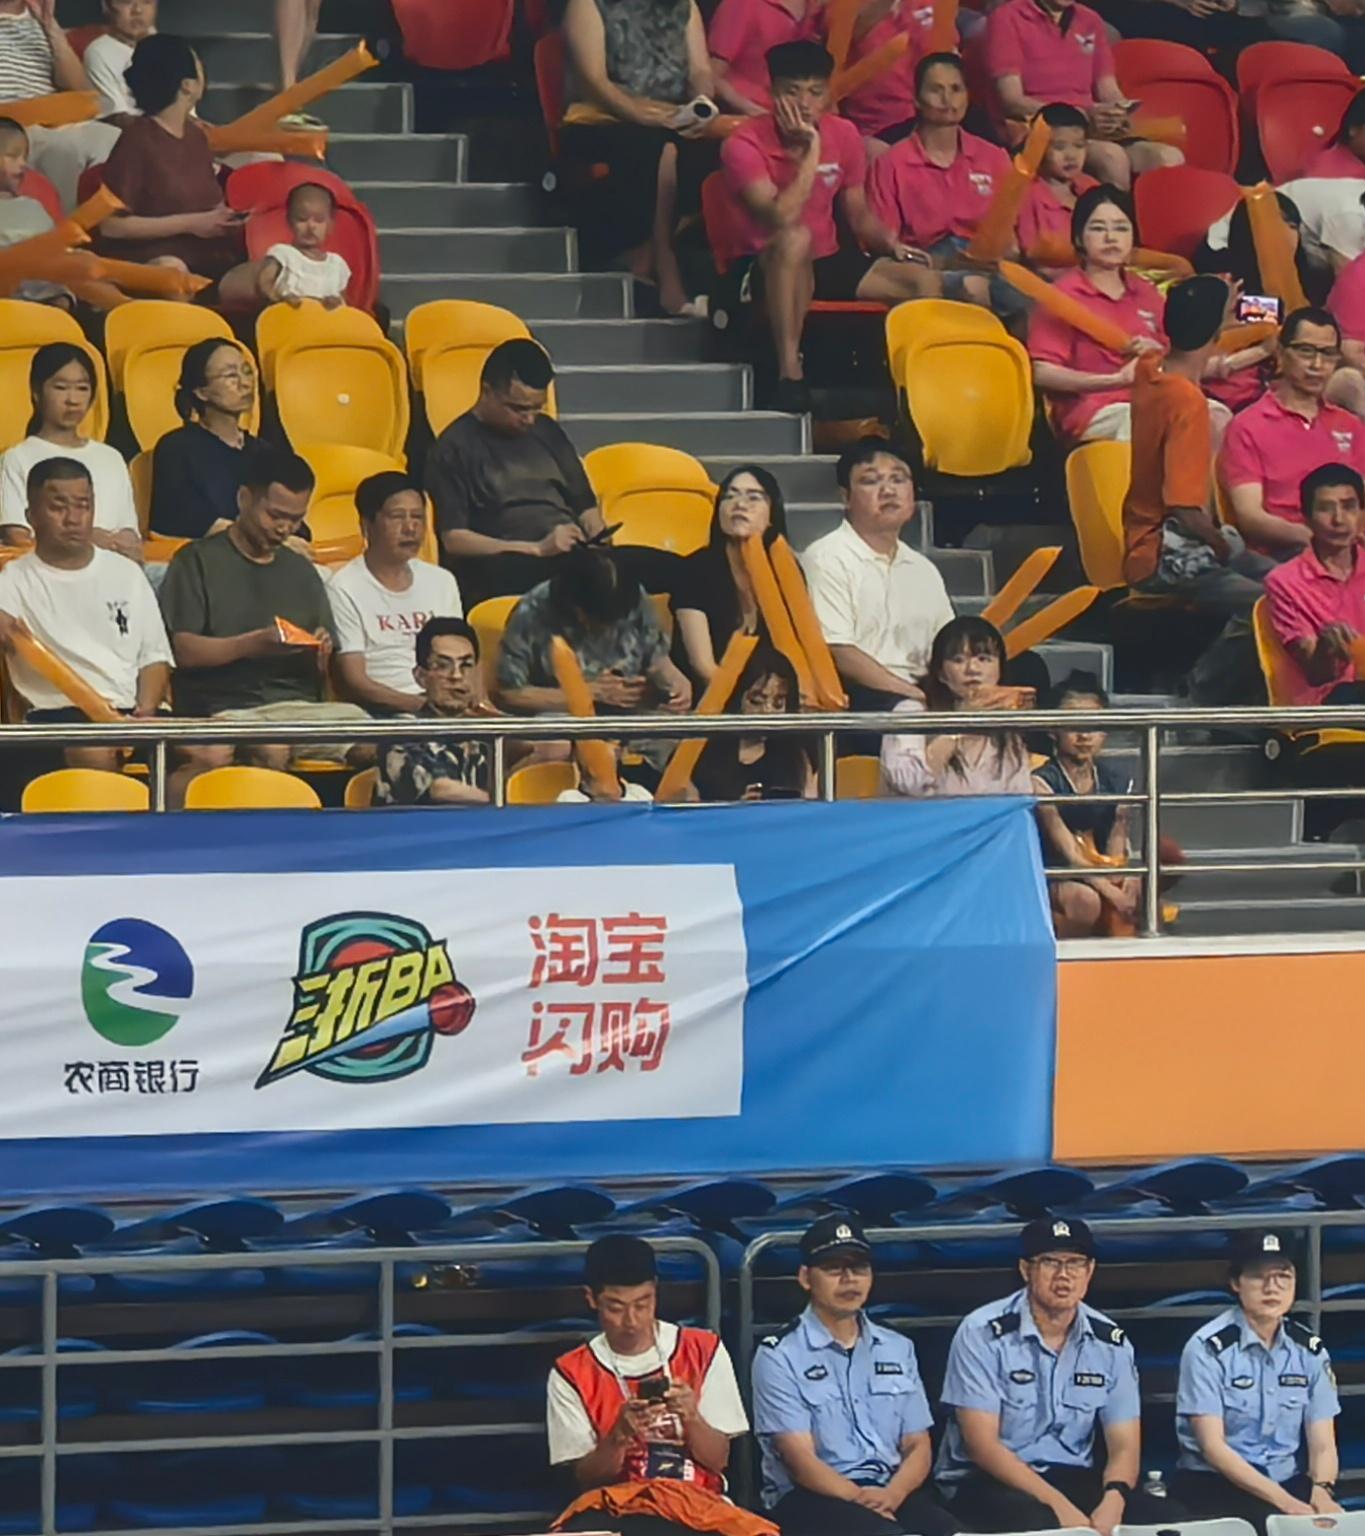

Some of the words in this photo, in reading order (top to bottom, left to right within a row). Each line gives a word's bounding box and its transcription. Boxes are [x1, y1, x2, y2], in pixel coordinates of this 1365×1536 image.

[528, 912, 668, 988] 淘宝
[521, 996, 670, 1076] 闪购
[64, 1060, 199, 1094] 农商银行
